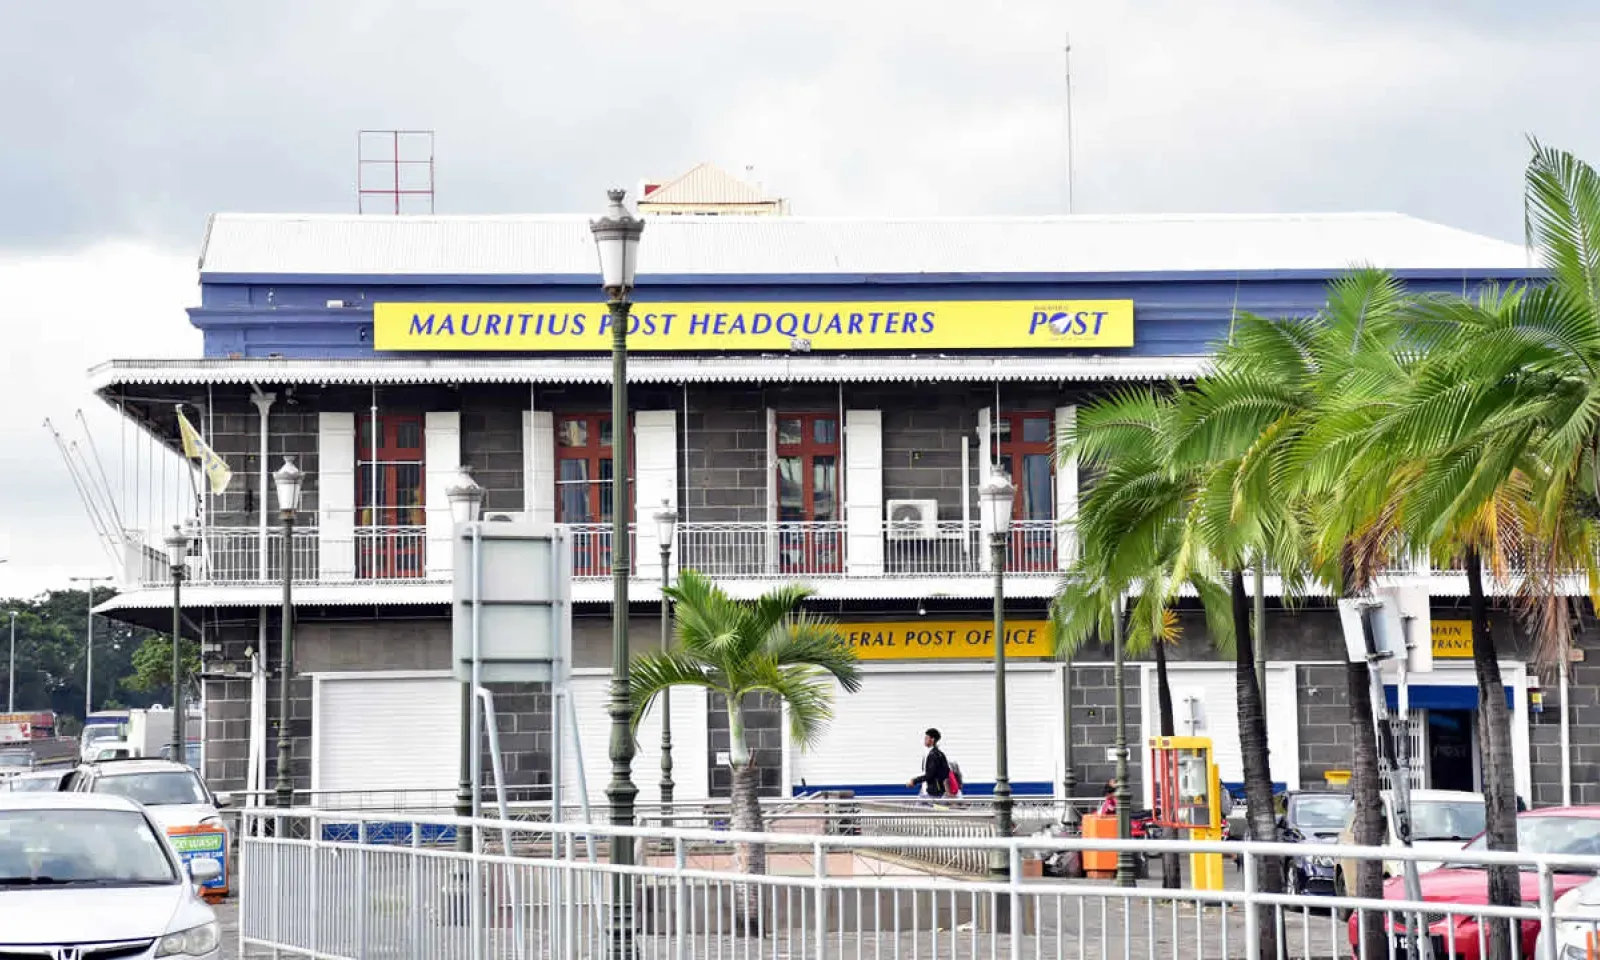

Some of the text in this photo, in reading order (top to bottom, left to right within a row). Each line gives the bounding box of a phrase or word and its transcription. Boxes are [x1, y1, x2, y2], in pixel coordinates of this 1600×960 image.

[409, 311, 935, 337] MAURITIUS POST HEADQUARTERS
[1028, 311, 1109, 335] POST
[905, 630, 956, 646] POST
[966, 629, 1037, 645] OFICE
[1431, 639, 1472, 649] TRANC
